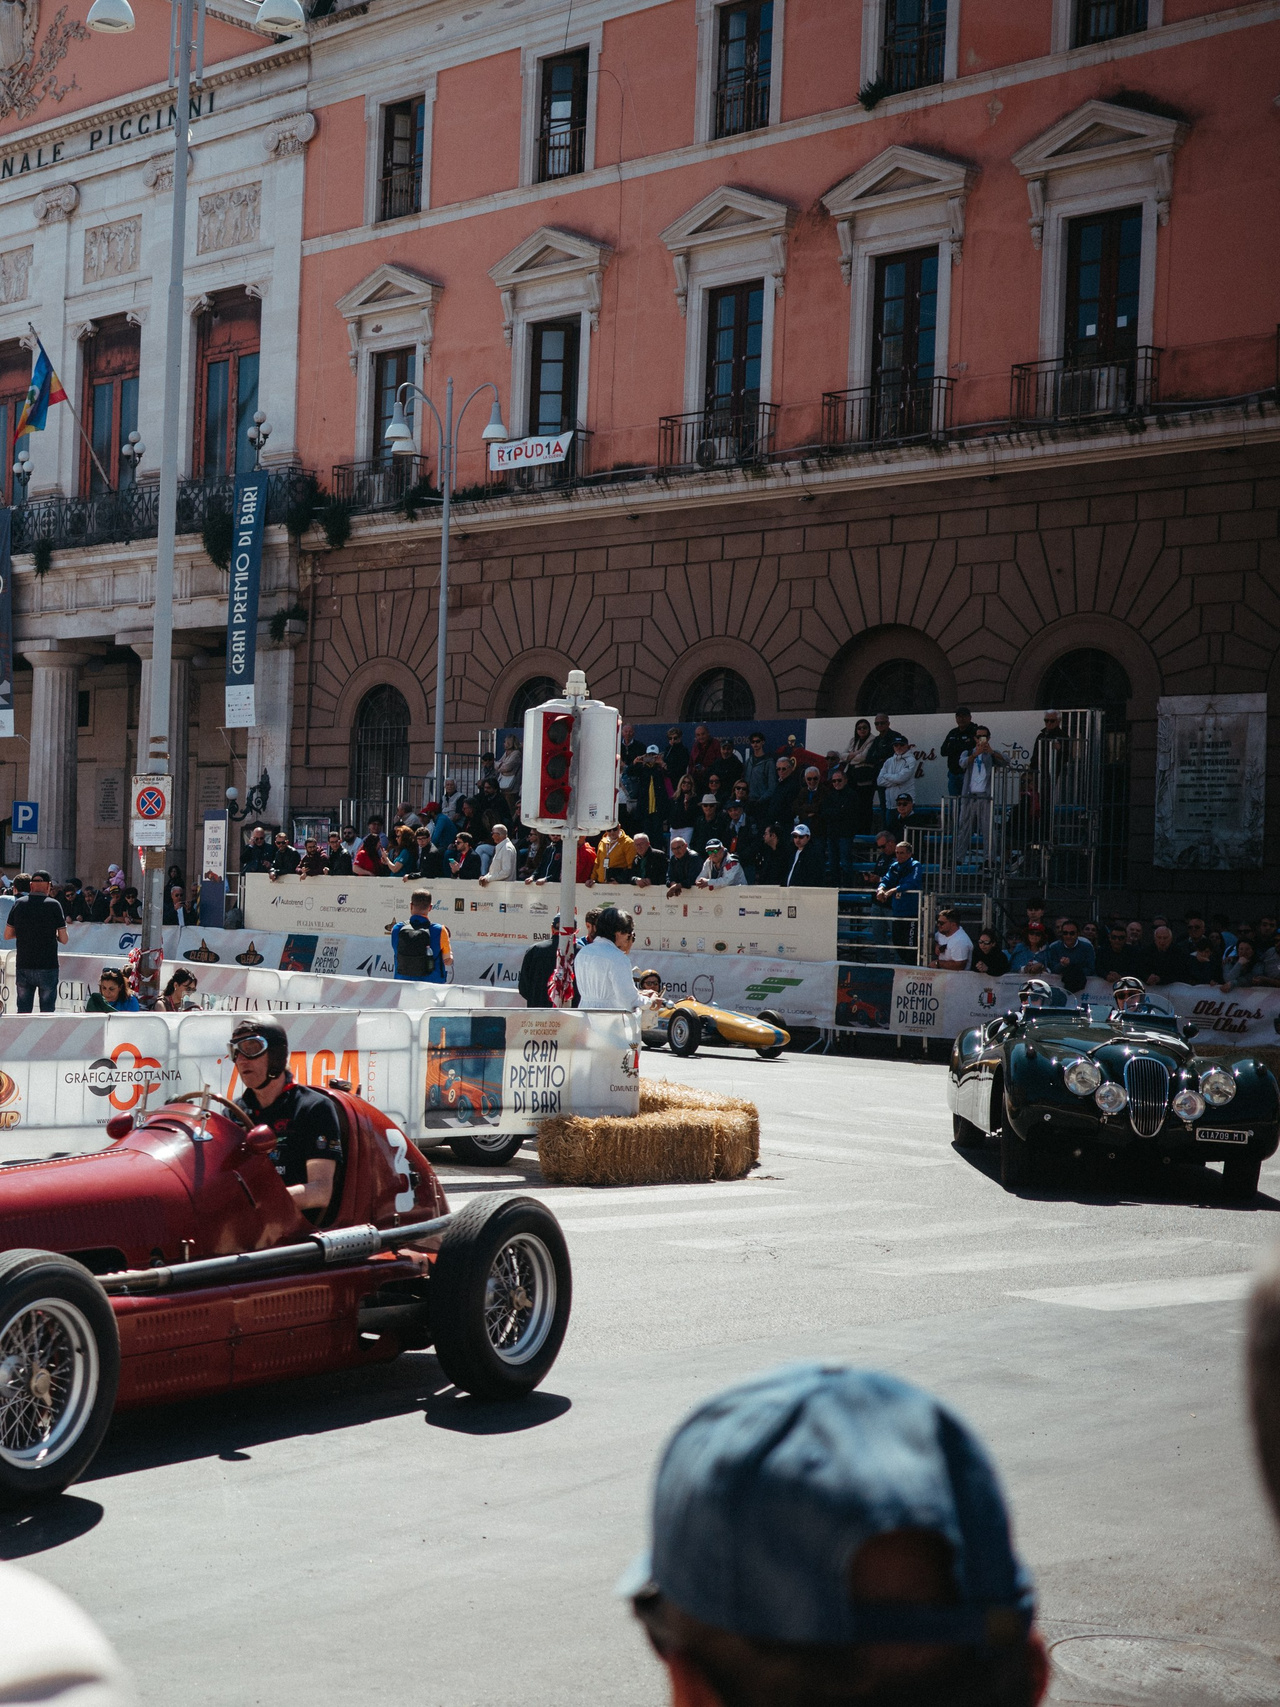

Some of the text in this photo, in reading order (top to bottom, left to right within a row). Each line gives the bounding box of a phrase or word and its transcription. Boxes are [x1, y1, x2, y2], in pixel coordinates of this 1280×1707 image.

[89, 91, 216, 152] PICCINNI
[240, 486, 258, 525] BARI
[238, 530, 252, 546] DI
[233, 552, 250, 623] PREMIO
[232, 630, 246, 674] GRAN
[18, 805, 33, 828] P
[314, 957, 340, 968] PREMIO
[905, 981, 933, 997] GRAN
[896, 996, 939, 1011] PREMIO
[1193, 1000, 1264, 1020] Old Cars
[534, 1020, 548, 1028] APRILE
[549, 1020, 561, 1028] 2026
[898, 1011, 935, 1026] DI BARI
[1212, 1017, 1249, 1033] Club
[523, 1040, 558, 1063] GRAN
[64, 1069, 182, 1084] GRAFICAZEROTTANTA
[368, 1050, 377, 1103] SPORT
[510, 1064, 566, 1088] PREMIO
[450, 1090, 455, 1101] 9
[514, 1091, 561, 1114] DI BARI
[1233, 1133, 1244, 1141] MI
